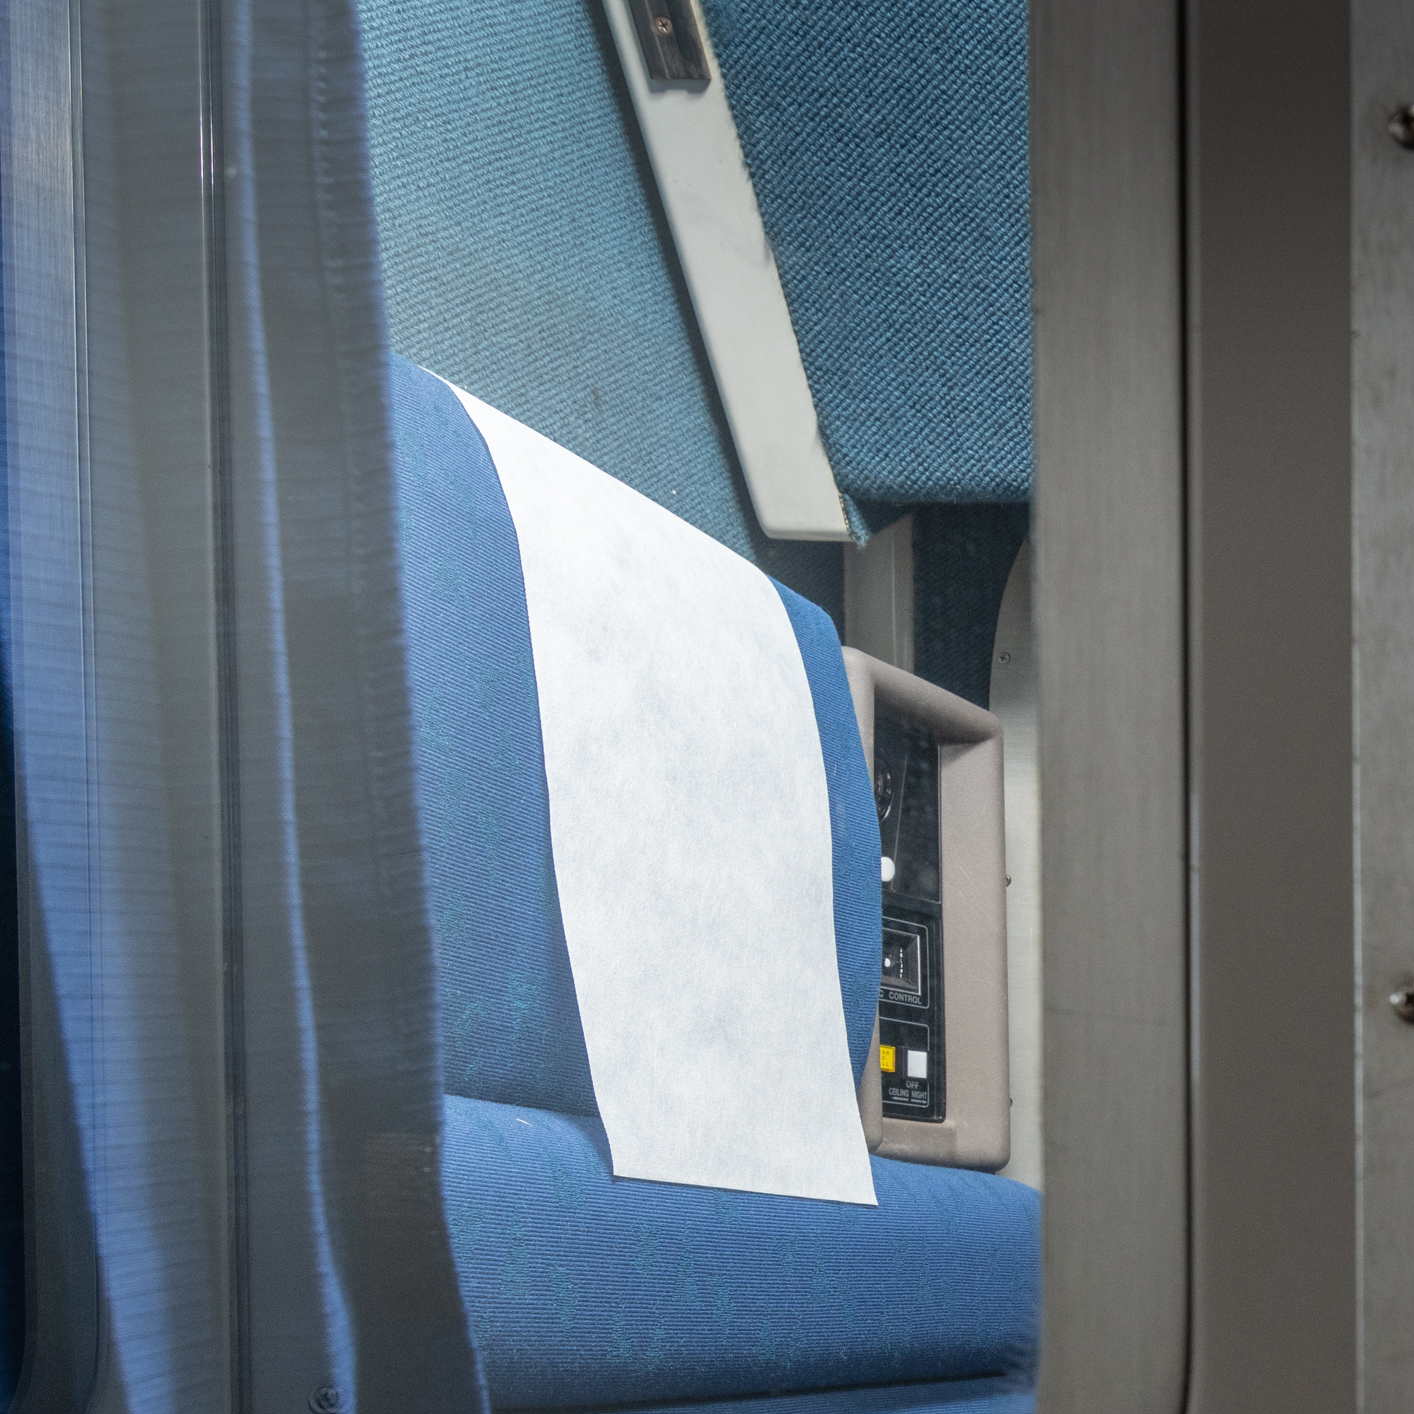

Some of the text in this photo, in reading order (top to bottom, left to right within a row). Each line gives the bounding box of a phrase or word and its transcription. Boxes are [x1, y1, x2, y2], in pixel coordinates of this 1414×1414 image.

[888, 991, 922, 1004] CONTROL
[905, 1080, 919, 1089] OFF
[889, 1087, 927, 1100] CEILING NIGHT
